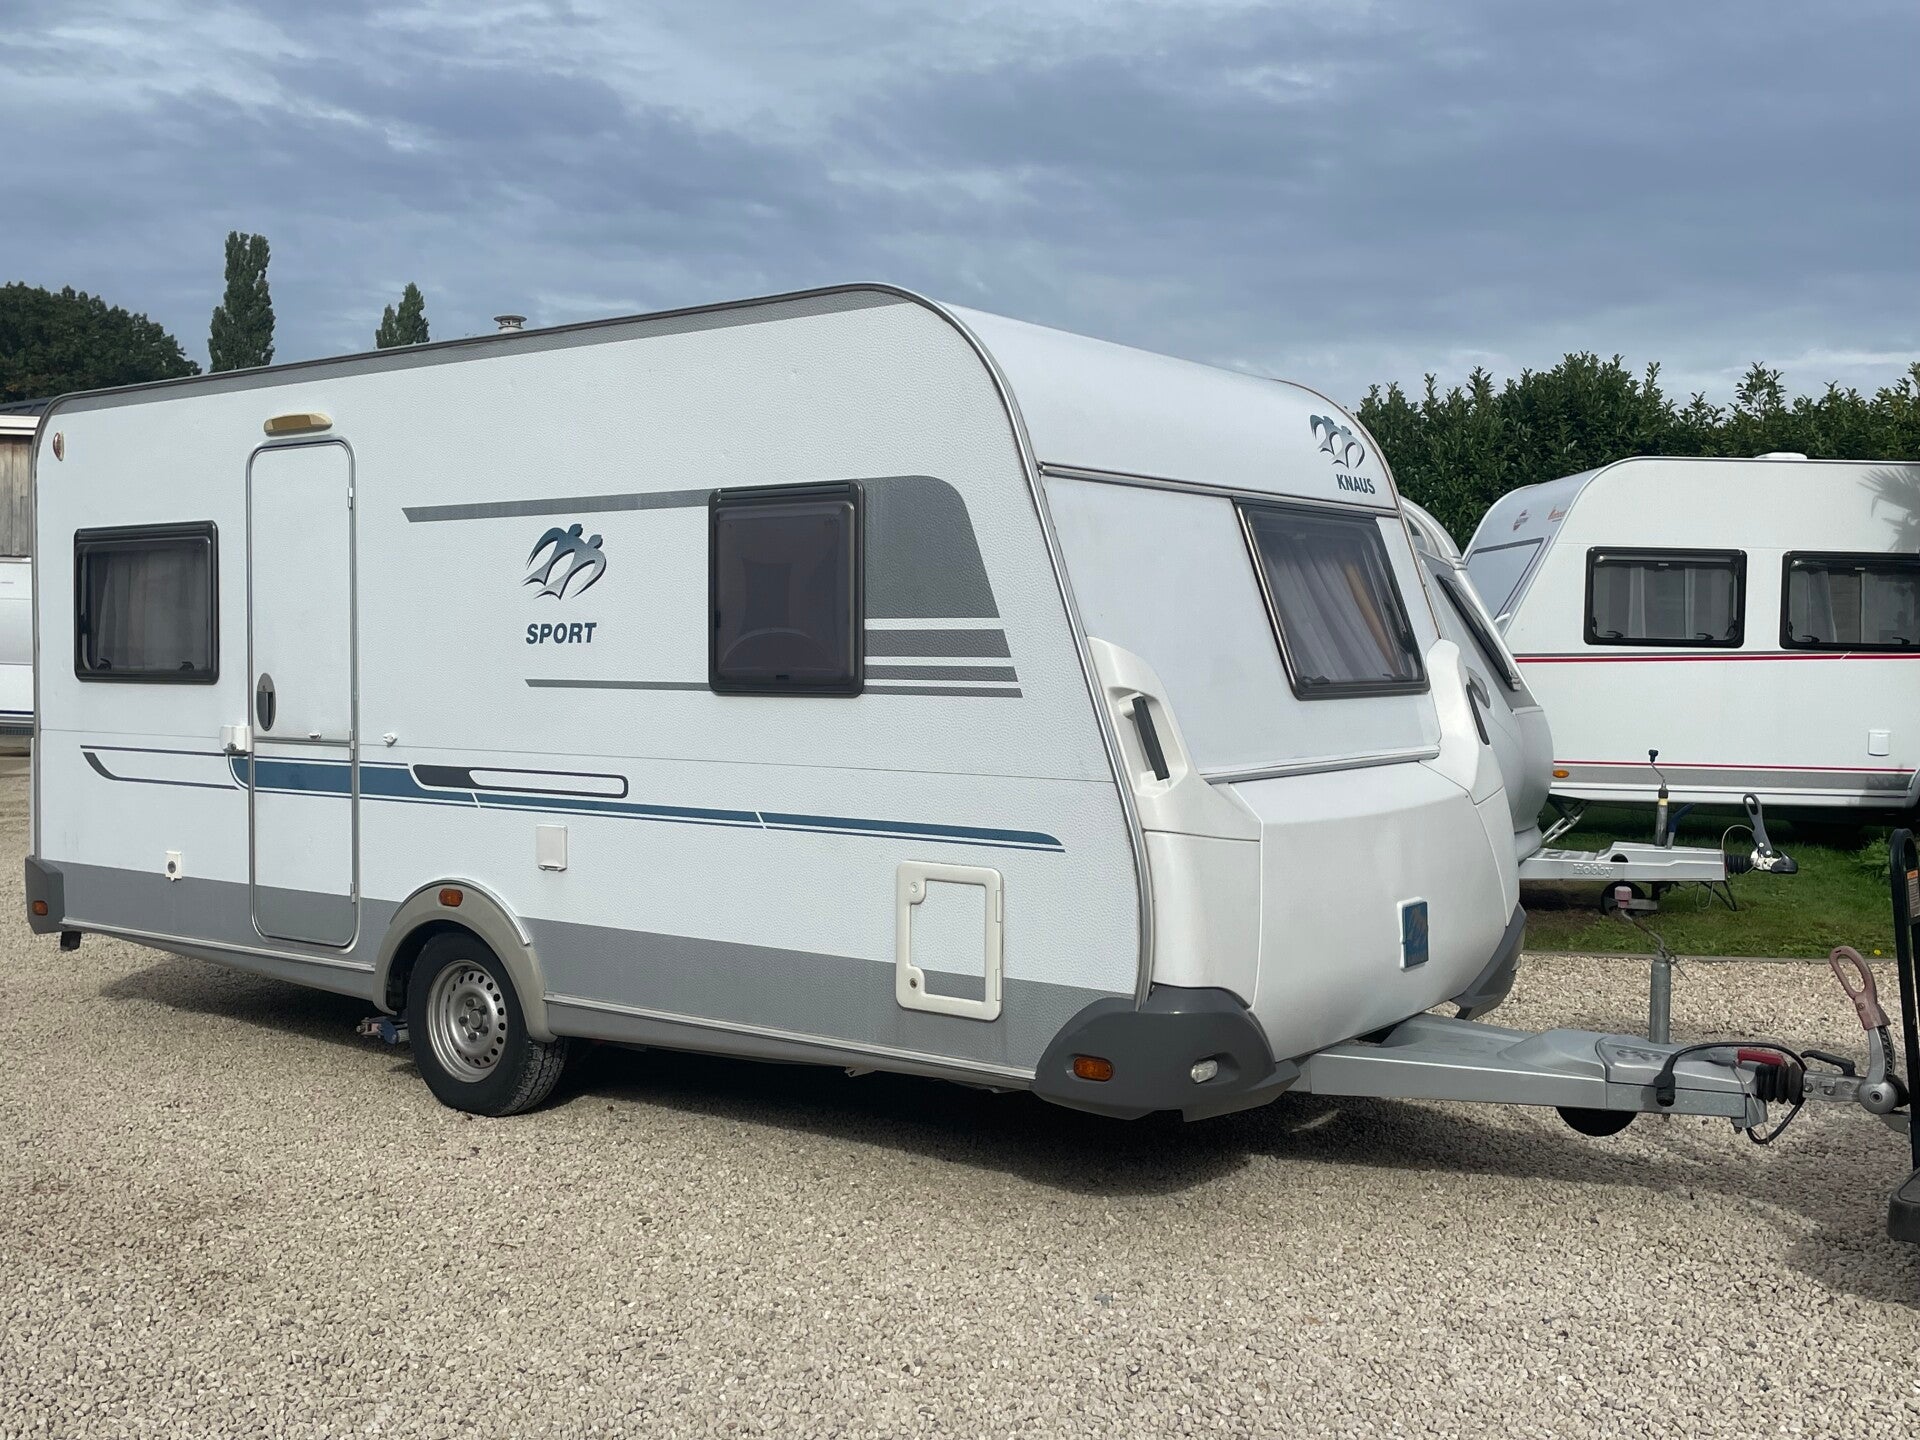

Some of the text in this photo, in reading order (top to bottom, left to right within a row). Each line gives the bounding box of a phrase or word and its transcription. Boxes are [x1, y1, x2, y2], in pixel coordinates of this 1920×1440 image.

[1336, 474, 1376, 494] KNAUS
[525, 622, 597, 644] SPORT
[1573, 863, 1614, 878] Hobby
